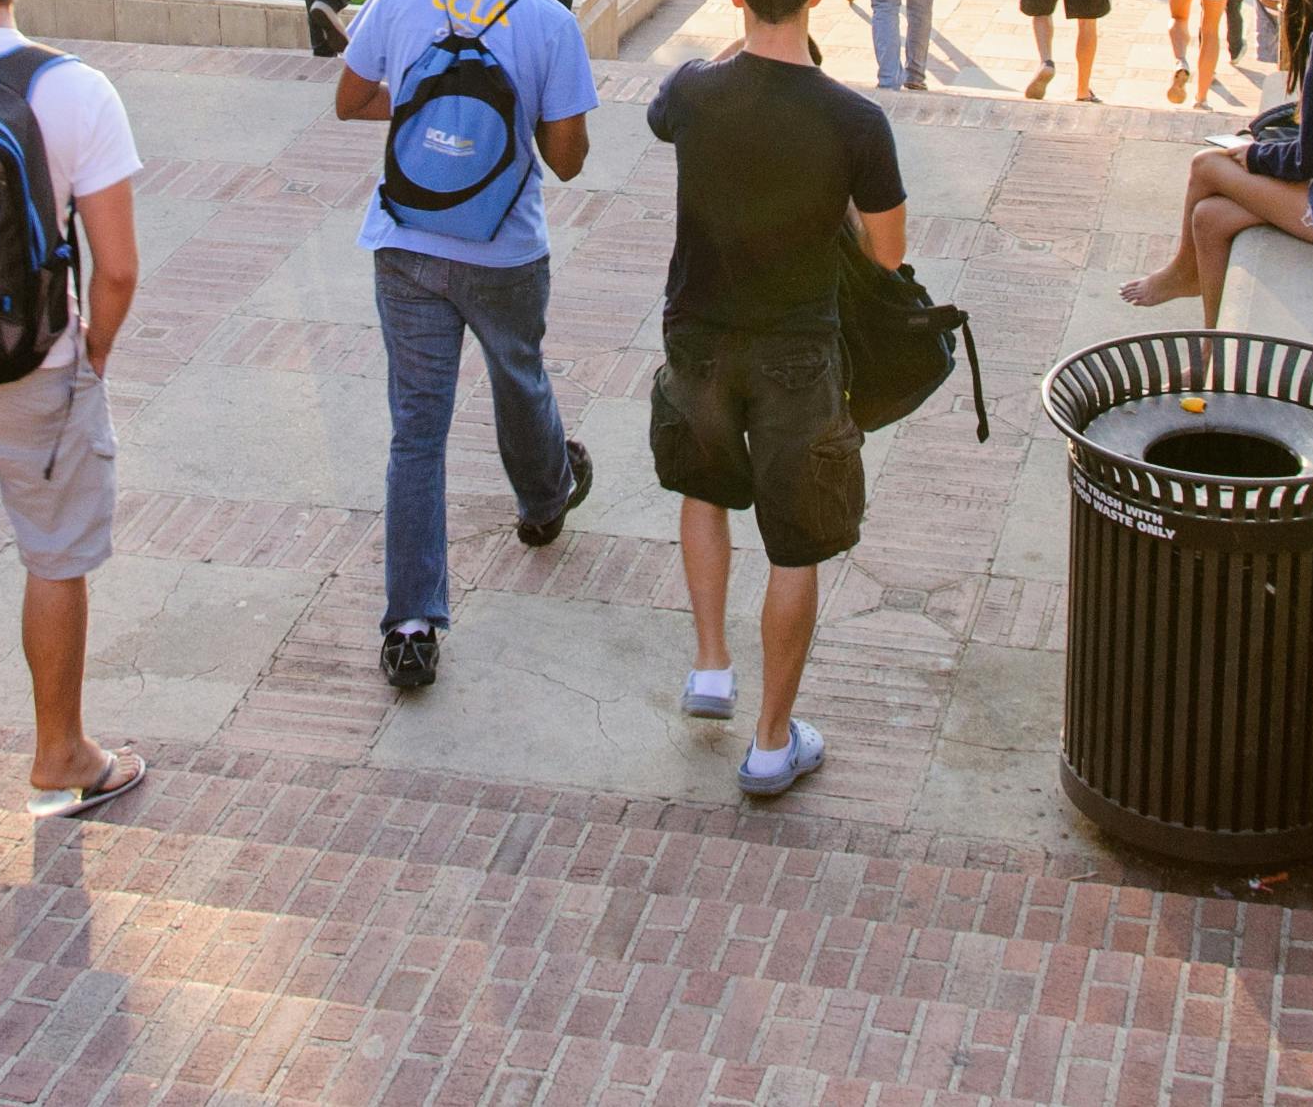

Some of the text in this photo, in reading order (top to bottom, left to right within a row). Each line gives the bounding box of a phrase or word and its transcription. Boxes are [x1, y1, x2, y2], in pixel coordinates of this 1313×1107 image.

[426, 127, 457, 148] UCLA
[1088, 482, 1123, 511] TRASH
[1125, 504, 1163, 525] WITH
[1093, 499, 1134, 528] WASTE
[1137, 520, 1176, 540] ONLY
